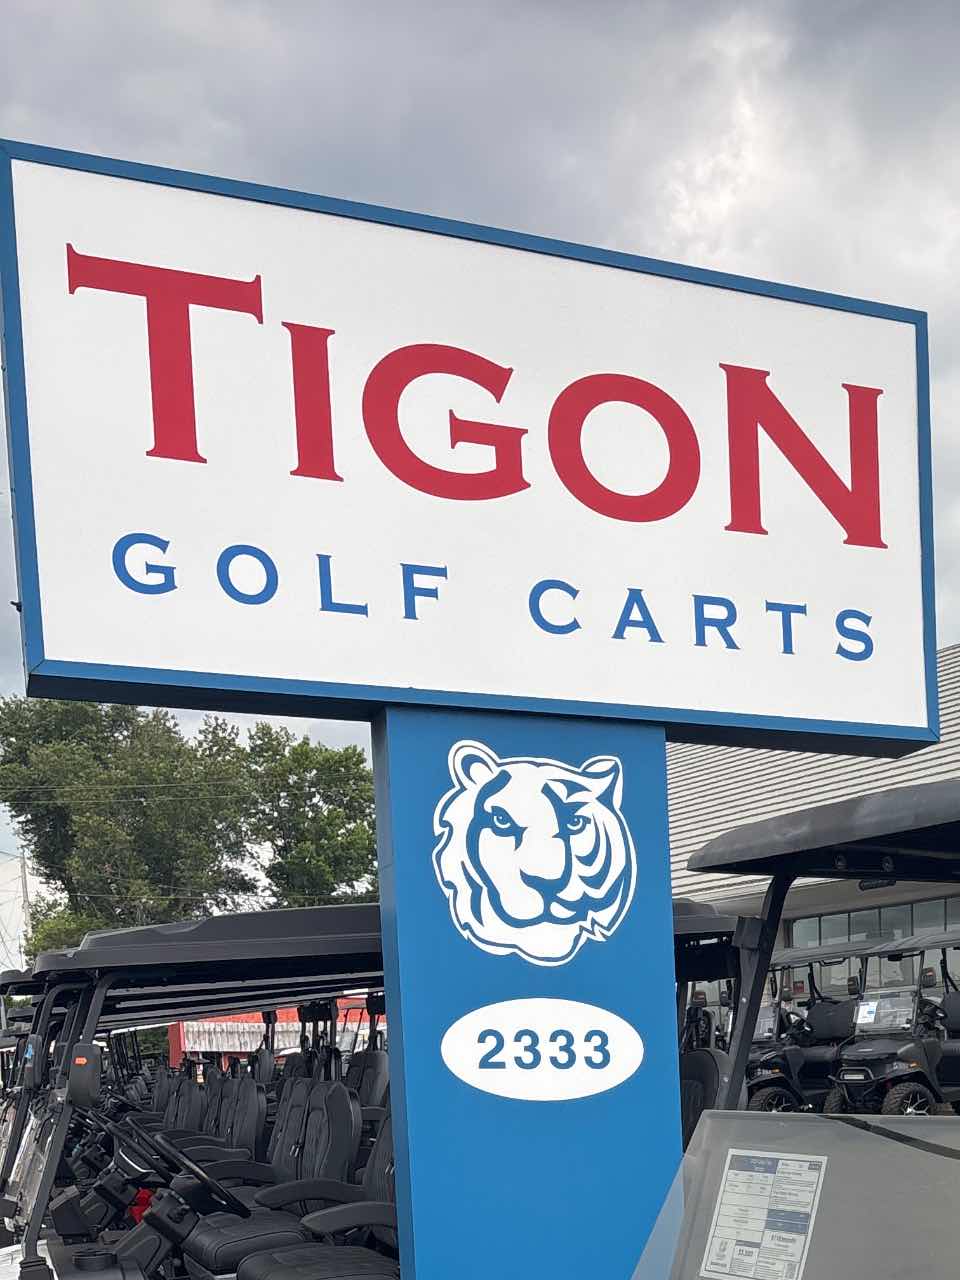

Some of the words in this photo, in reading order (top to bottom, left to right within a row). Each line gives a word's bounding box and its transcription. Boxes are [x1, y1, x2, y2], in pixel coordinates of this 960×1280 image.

[66, 243, 888, 549] TIGON
[111, 532, 449, 620] GOLF
[528, 578, 875, 662] CARTS
[477, 1028, 611, 1070] 2333
